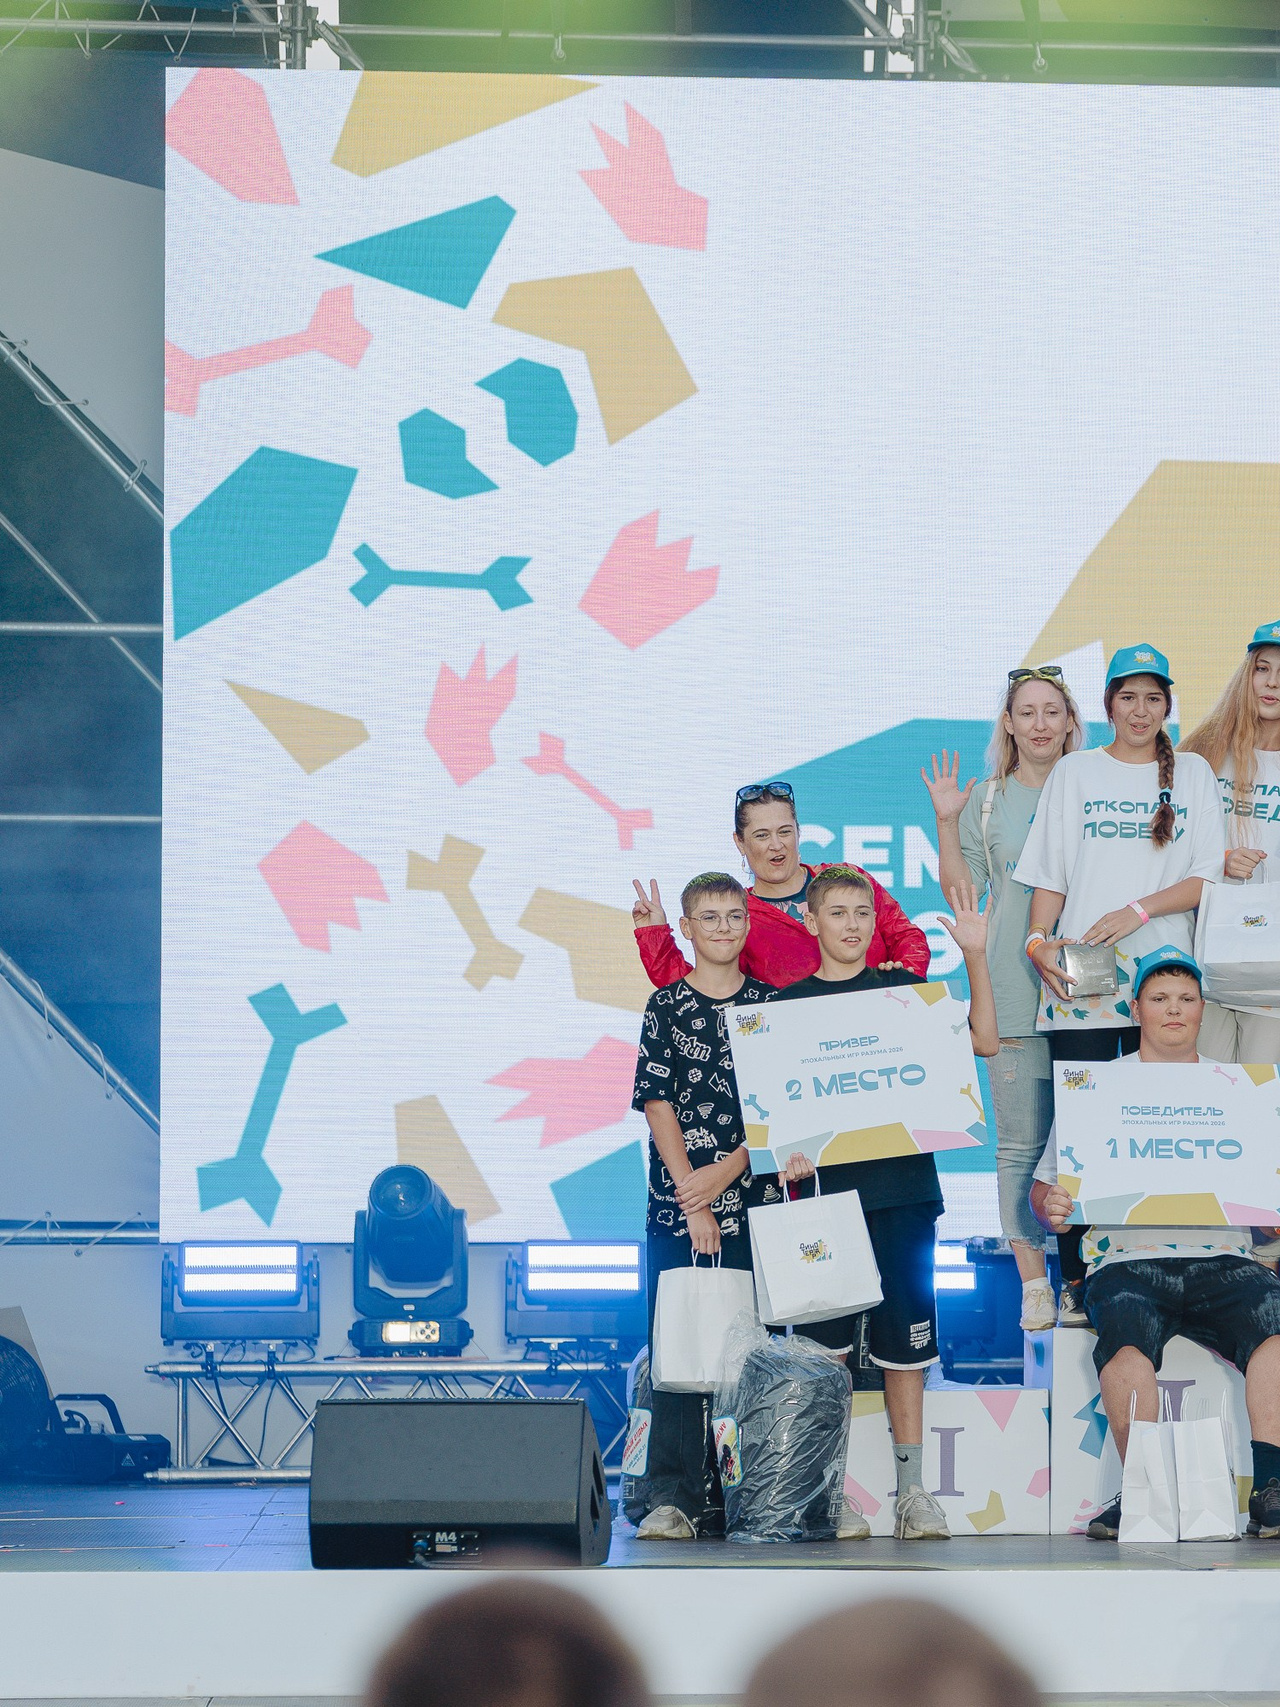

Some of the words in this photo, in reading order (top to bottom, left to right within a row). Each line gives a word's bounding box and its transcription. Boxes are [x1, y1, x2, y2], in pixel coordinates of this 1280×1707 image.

[1083, 800, 1188, 820] ОТКОПАИ
[1083, 820, 1186, 844] ПОБЕУ
[818, 1035, 880, 1052] ПРИЗЕР
[800, 1053, 846, 1065] ЭПОХАЛЬНЫХ
[846, 1051, 860, 1059] ИГР
[860, 1048, 888, 1057] РАЗУМА
[785, 1079, 802, 1101] 2
[812, 1063, 927, 1098] МЕСТО
[1121, 1105, 1224, 1117] ПОБЕДИТЕЛЬ
[1105, 1137, 1119, 1159] 1
[1129, 1138, 1243, 1160] МЕСТО
[434, 1531, 457, 1542] M4
